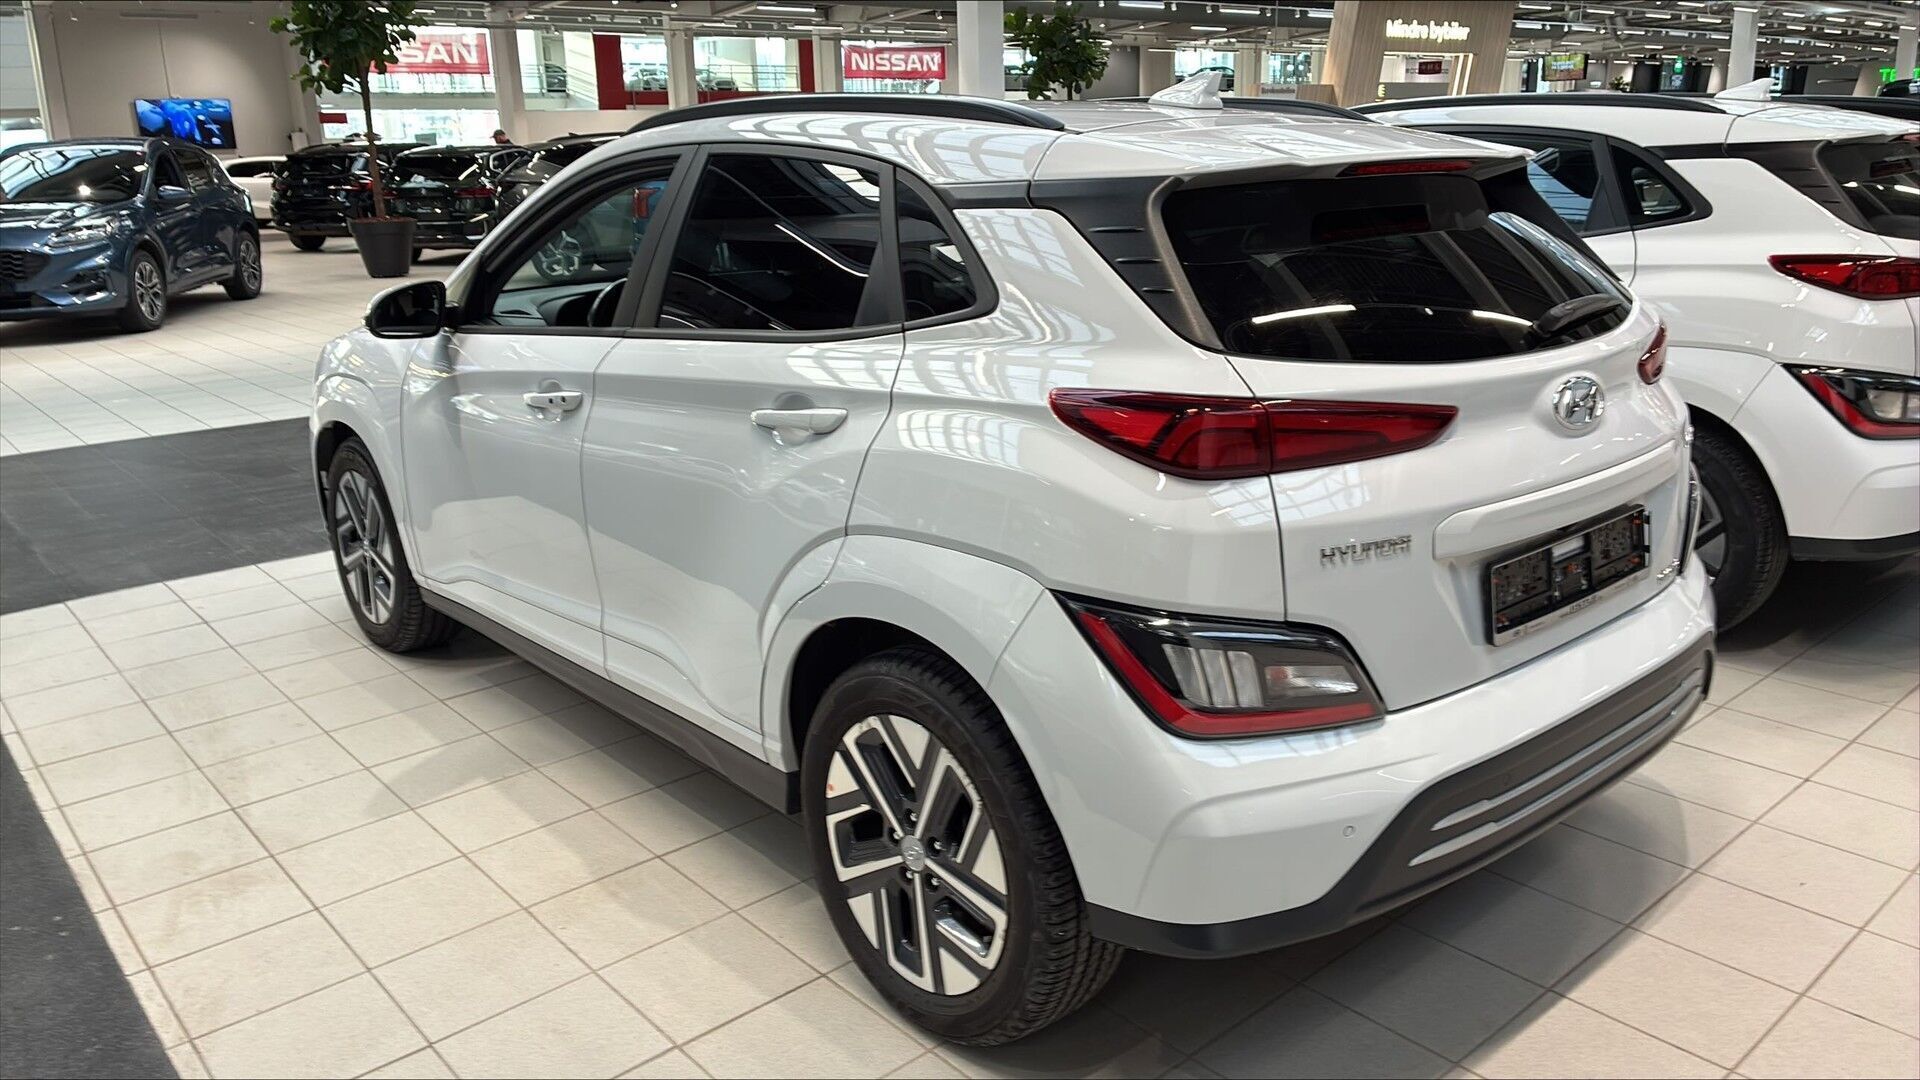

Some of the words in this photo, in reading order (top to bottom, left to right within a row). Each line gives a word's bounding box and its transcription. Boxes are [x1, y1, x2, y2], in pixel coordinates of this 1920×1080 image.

[1386, 19, 1428, 39] Mindre
[1429, 20, 1470, 43] bybiler
[394, 40, 479, 64] SAN
[851, 52, 940, 71] NISSAN
[1320, 535, 1412, 567] HYUNDAI
